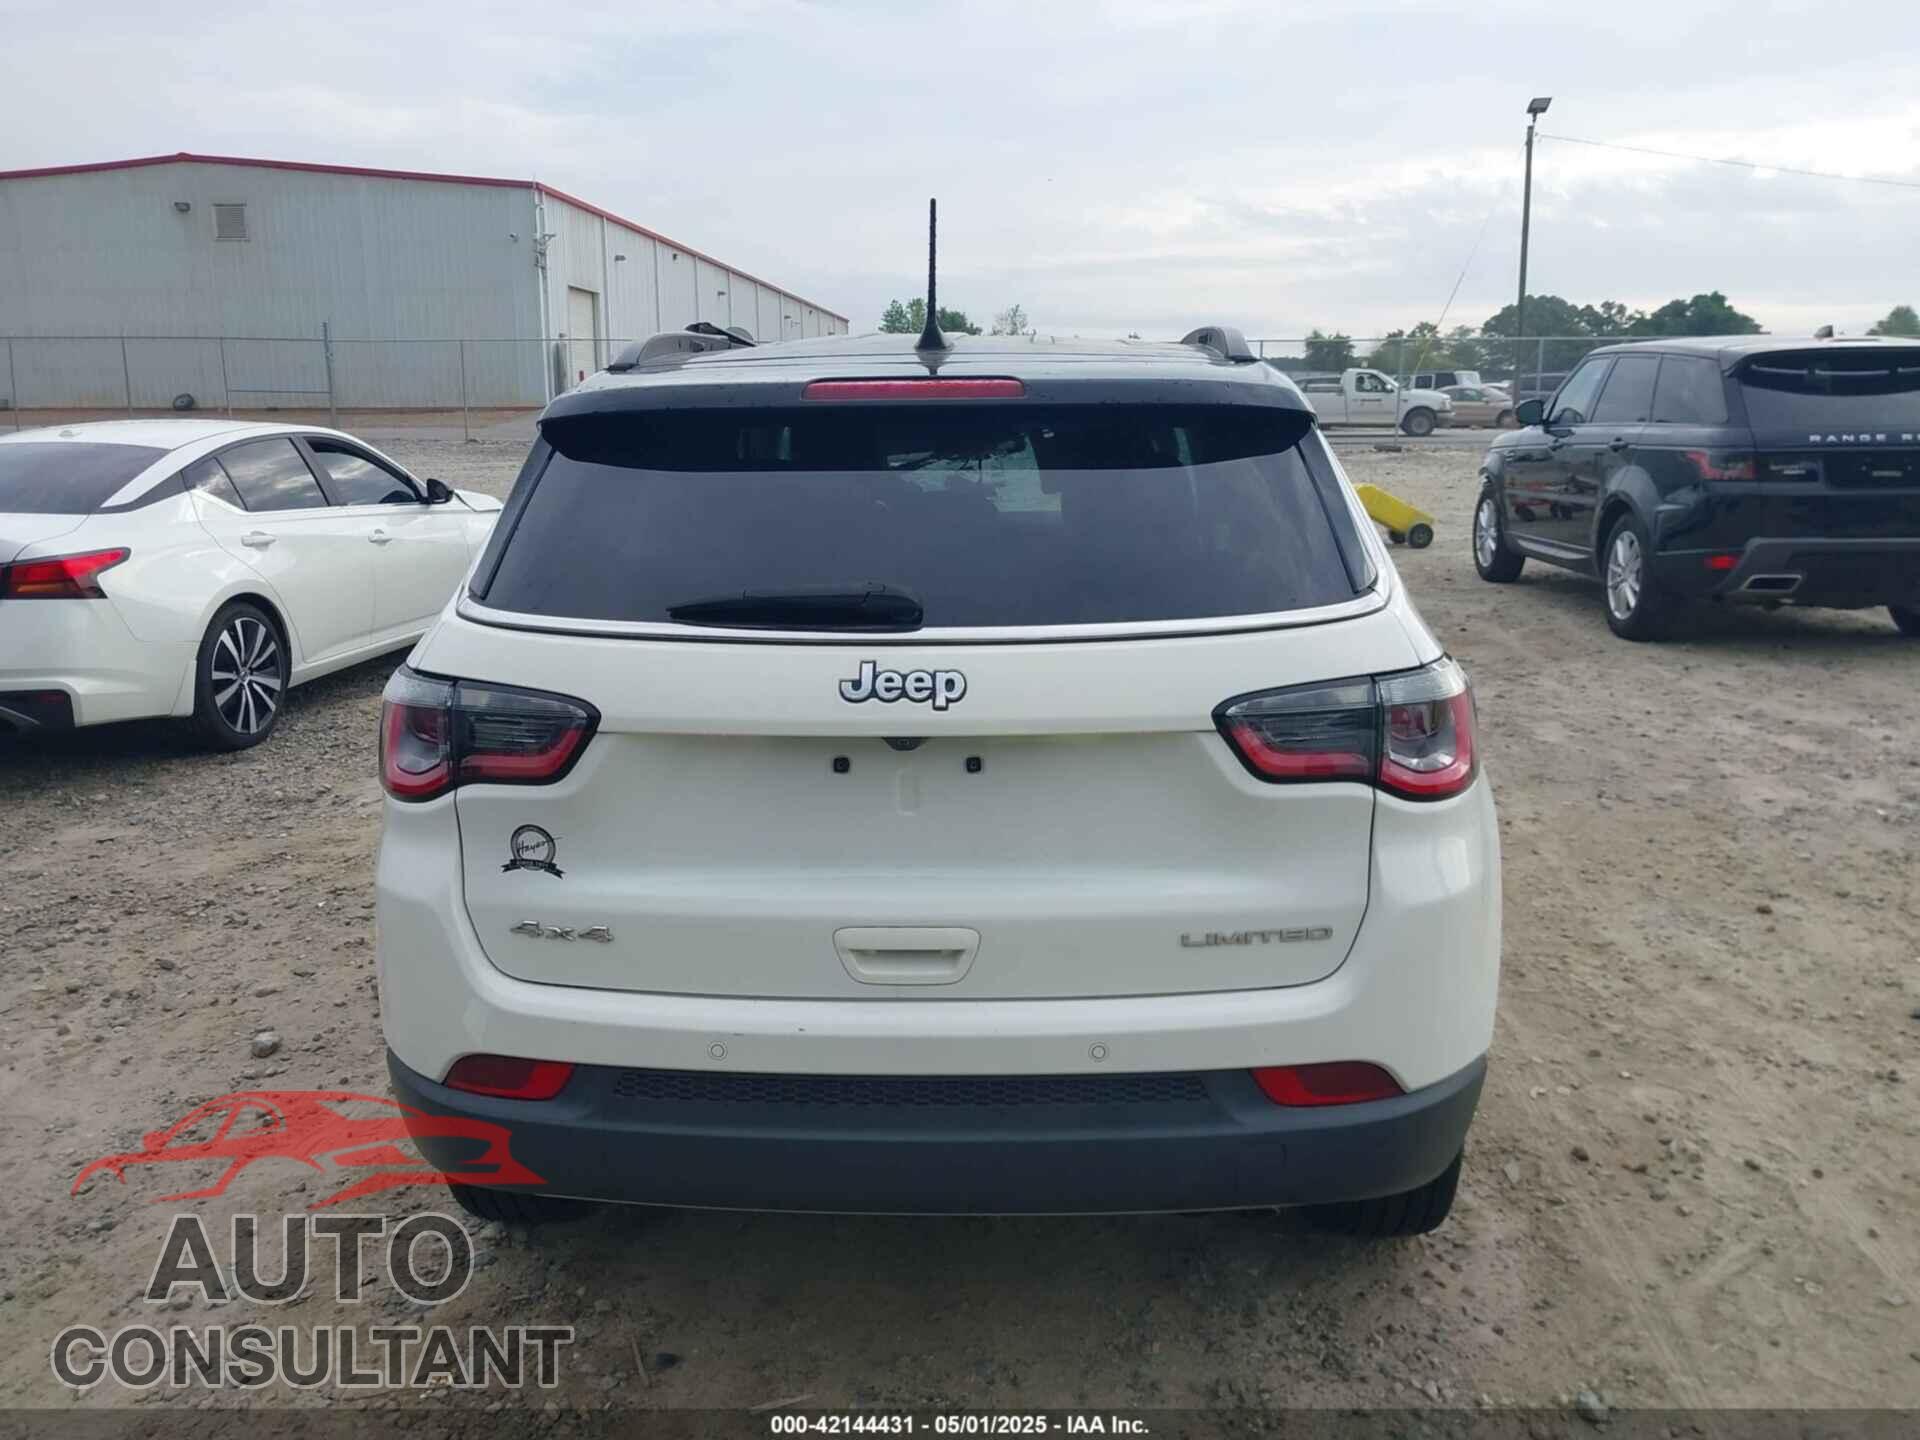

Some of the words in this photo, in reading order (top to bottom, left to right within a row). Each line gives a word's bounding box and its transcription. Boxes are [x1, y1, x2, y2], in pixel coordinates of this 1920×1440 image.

[1808, 433, 1887, 442] RANGE
[839, 660, 967, 711] Jeep
[510, 920, 614, 943] 4x4
[1179, 926, 1333, 948] LIMITED
